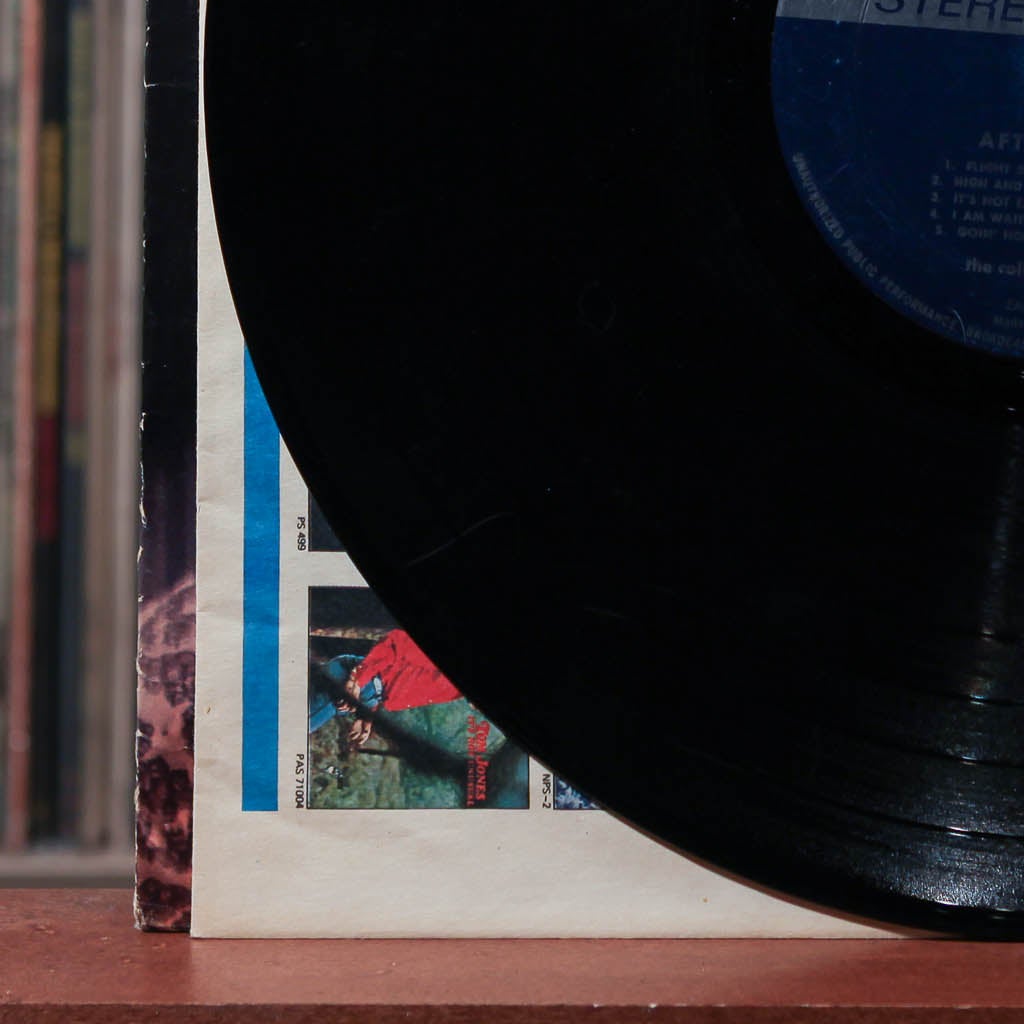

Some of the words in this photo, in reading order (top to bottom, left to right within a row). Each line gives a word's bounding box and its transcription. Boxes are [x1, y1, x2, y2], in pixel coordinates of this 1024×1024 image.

[296, 516, 306, 530] PS
[296, 532, 307, 551] 499
[295, 753, 305, 775] PAS
[475, 756, 491, 801] JONES
[542, 773, 552, 809] NPS-2
[295, 778, 305, 809] 71004
